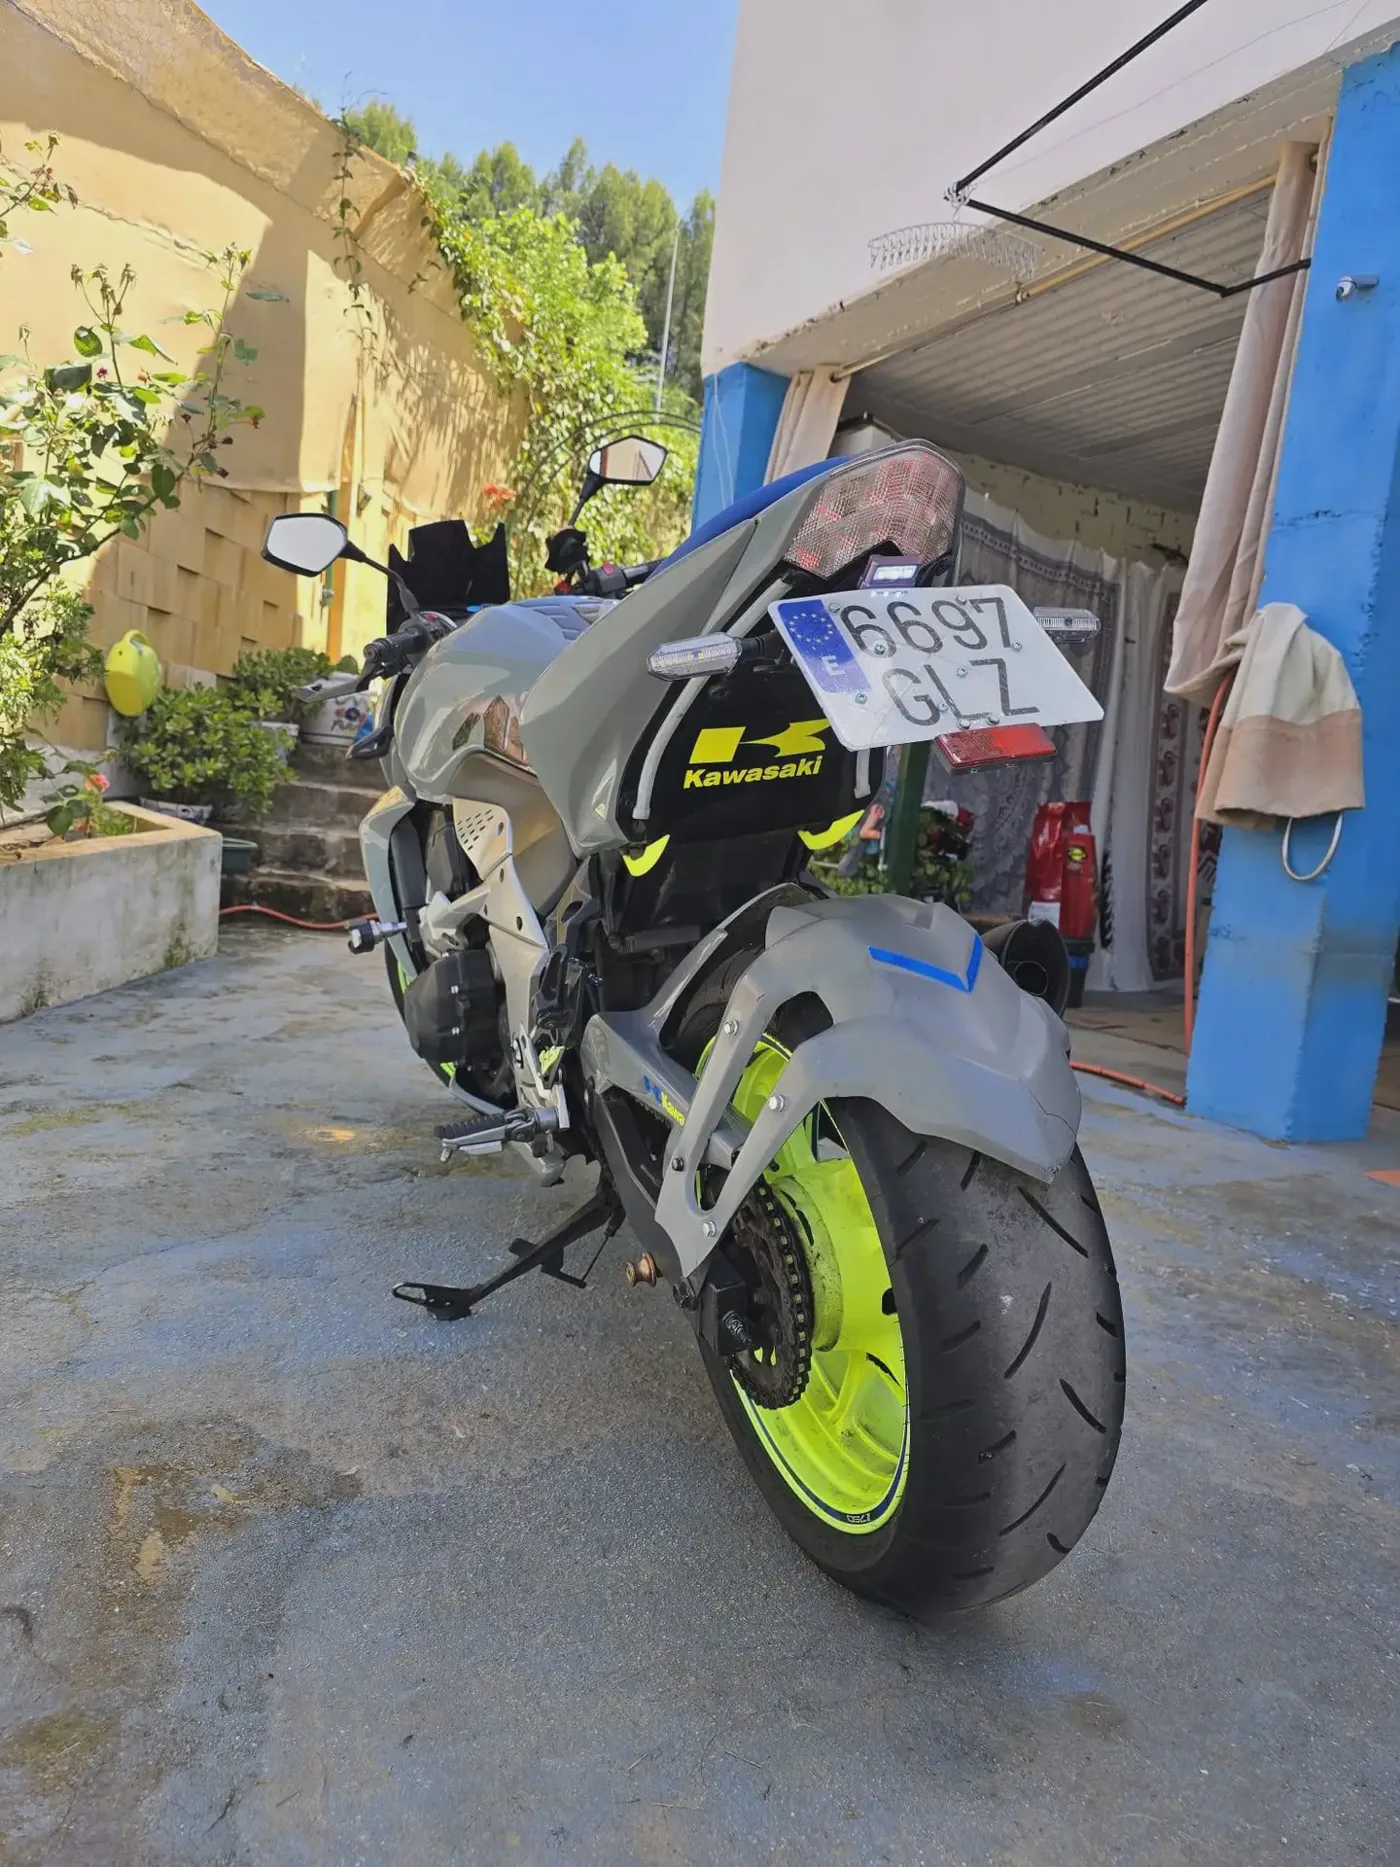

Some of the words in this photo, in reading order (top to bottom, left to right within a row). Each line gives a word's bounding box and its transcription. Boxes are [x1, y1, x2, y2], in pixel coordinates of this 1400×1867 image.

[840, 596, 1012, 659] 6697
[820, 654, 846, 676] E
[881, 657, 1041, 727] GLZ
[683, 755, 823, 790] Kawasaki
